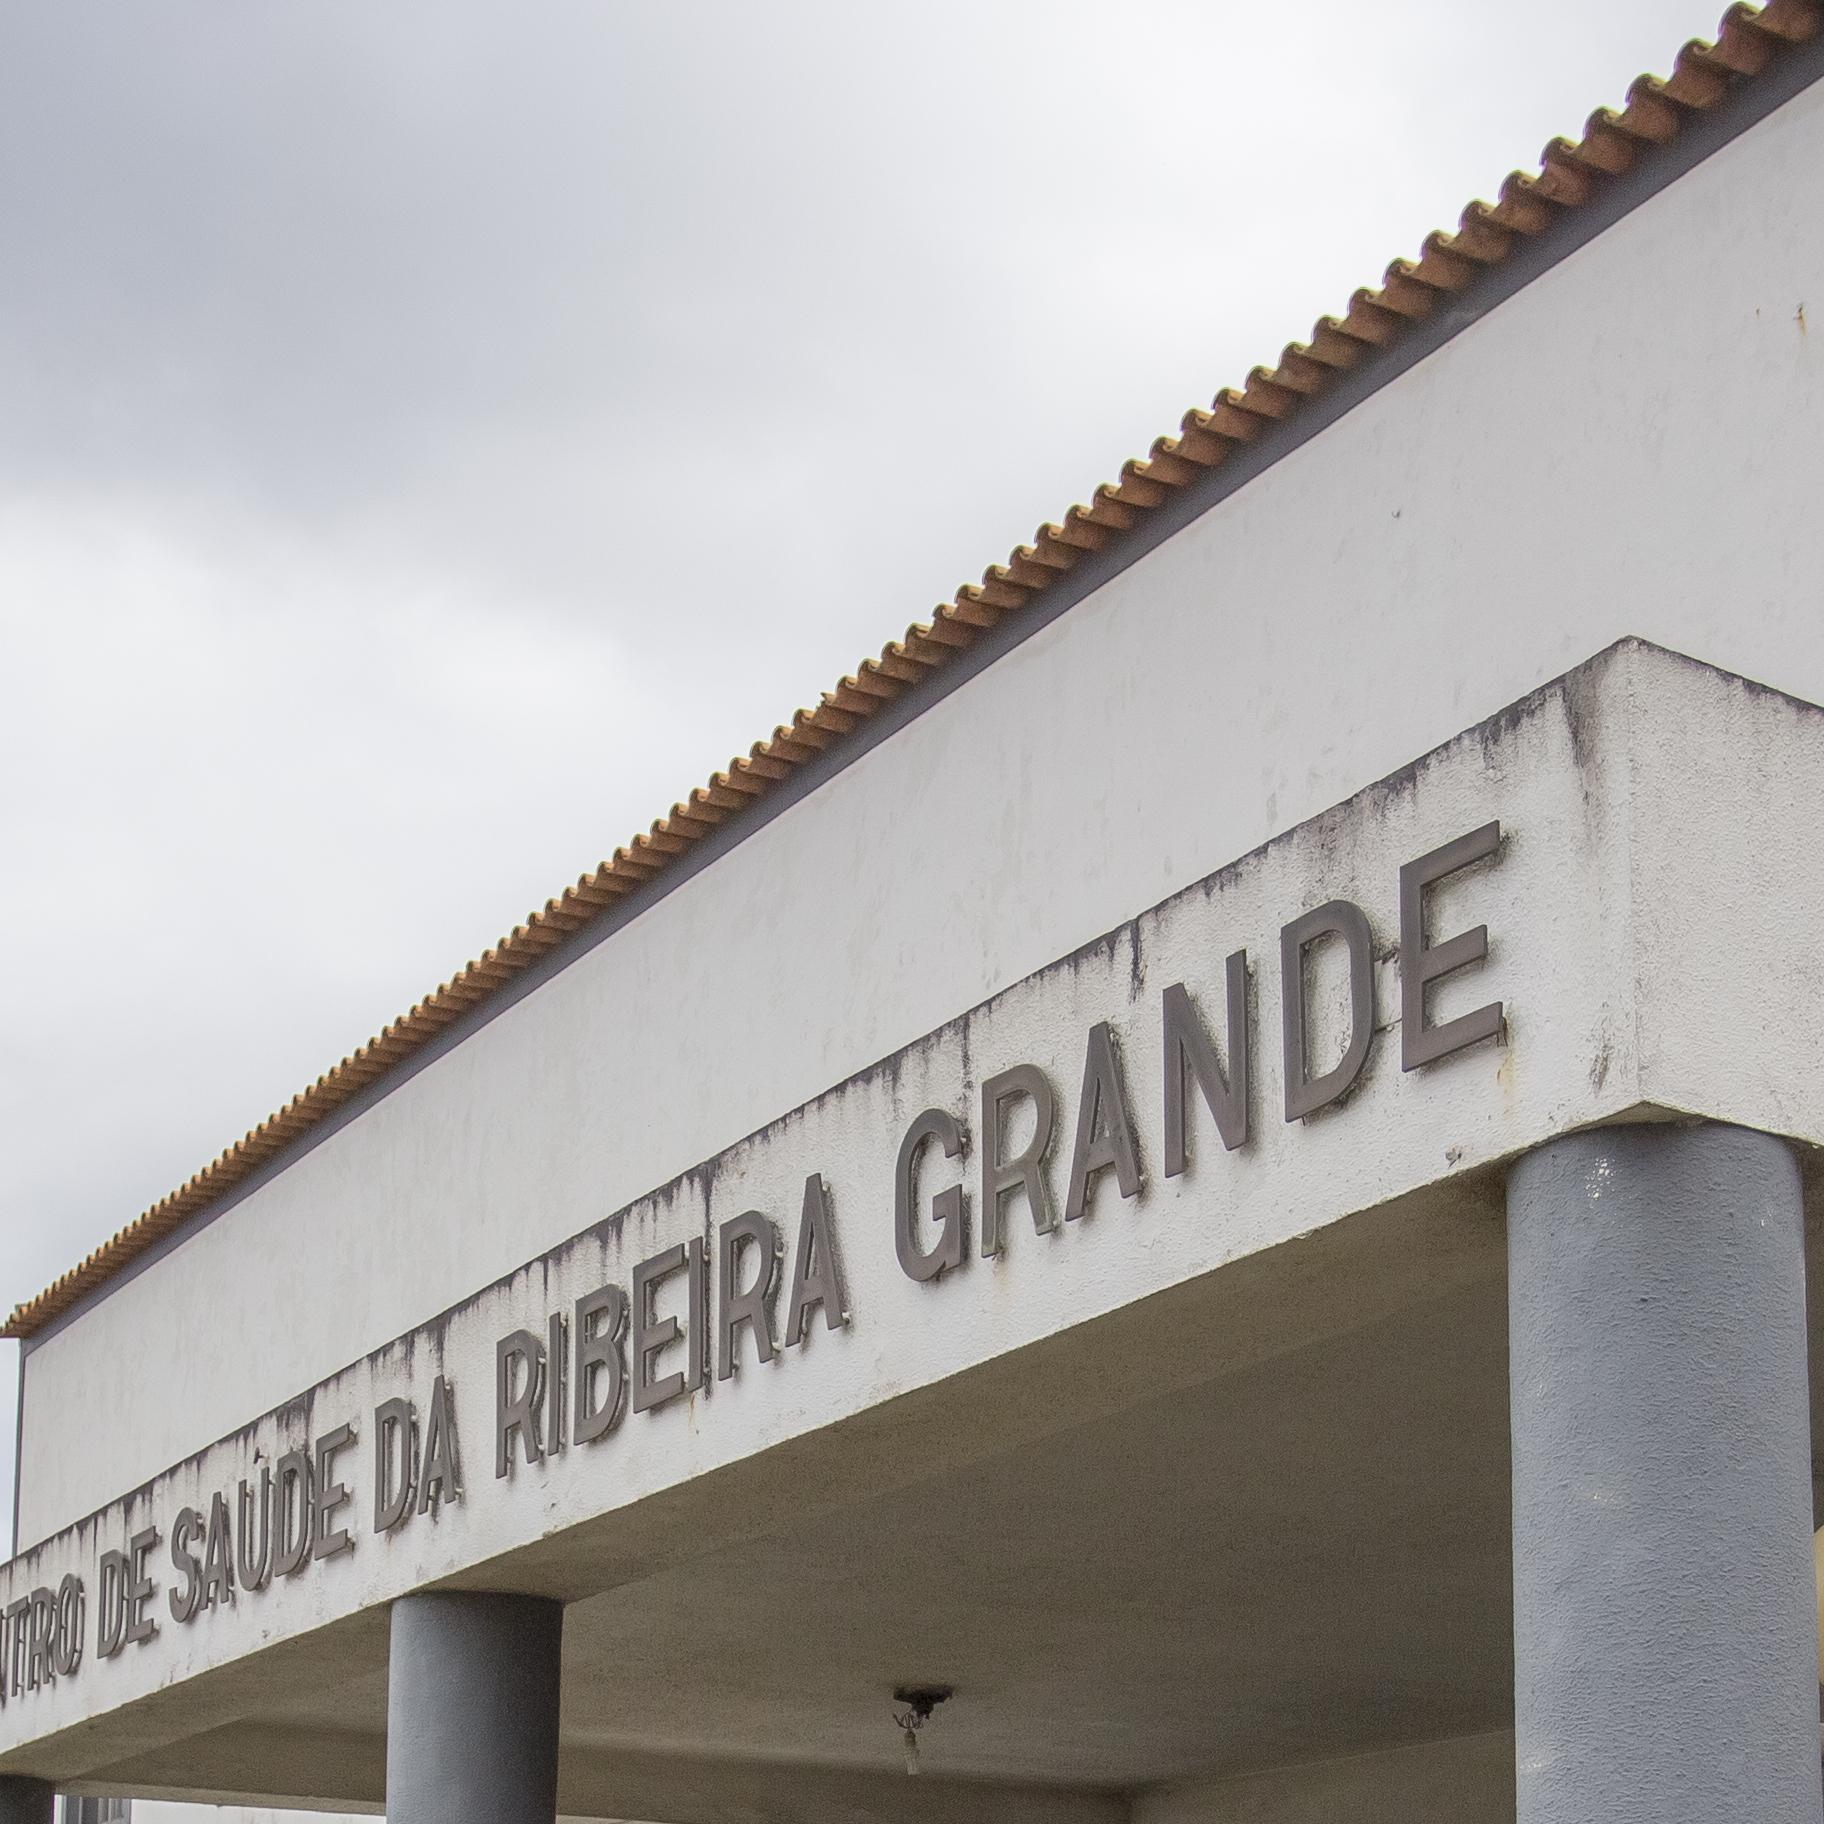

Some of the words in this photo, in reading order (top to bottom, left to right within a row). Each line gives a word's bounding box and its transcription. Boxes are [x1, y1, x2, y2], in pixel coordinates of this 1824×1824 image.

[97, 1525, 161, 1659] DE
[169, 1423, 351, 1623] SAÚDE
[374, 1376, 463, 1534] DA
[496, 1173, 848, 1479] RIBEIRA
[894, 820, 1504, 1283] GRANDE
